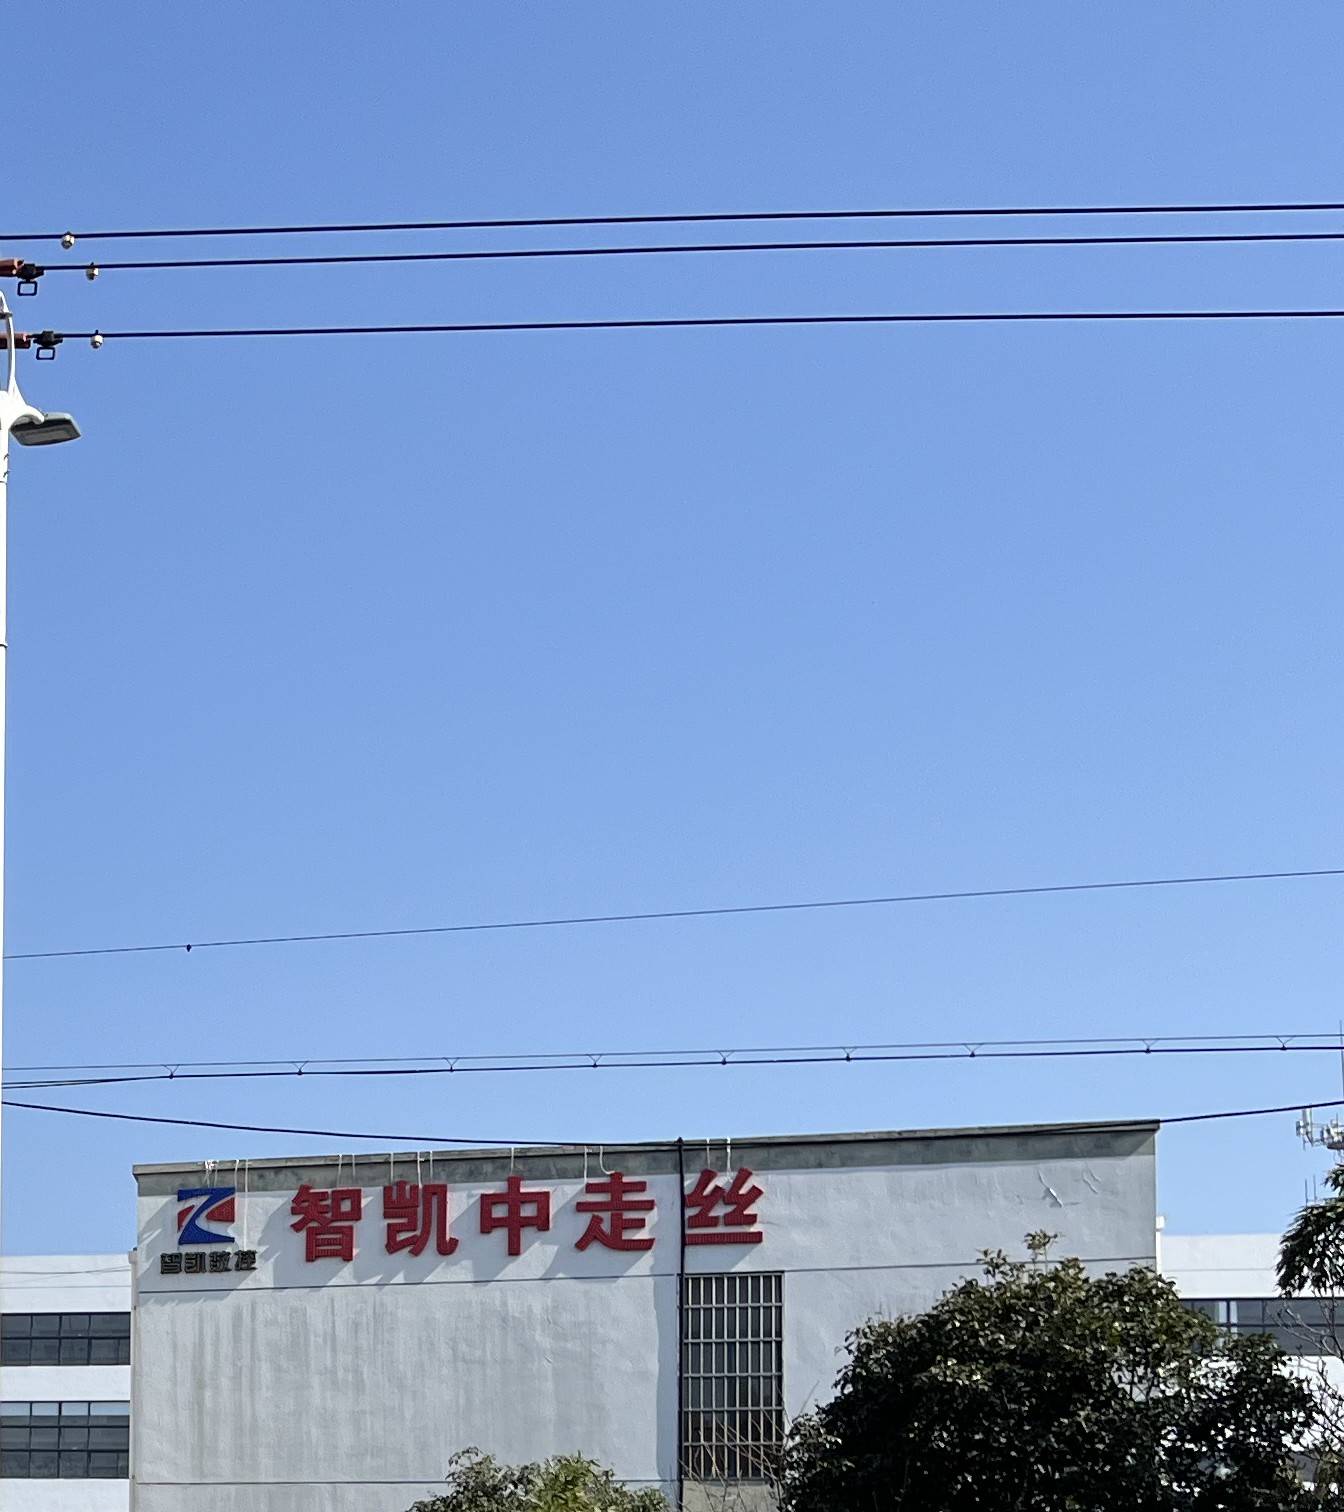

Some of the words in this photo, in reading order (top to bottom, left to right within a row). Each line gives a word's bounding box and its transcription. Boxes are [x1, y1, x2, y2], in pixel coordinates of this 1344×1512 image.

[290, 1168, 763, 1262] 智凯中走丝
